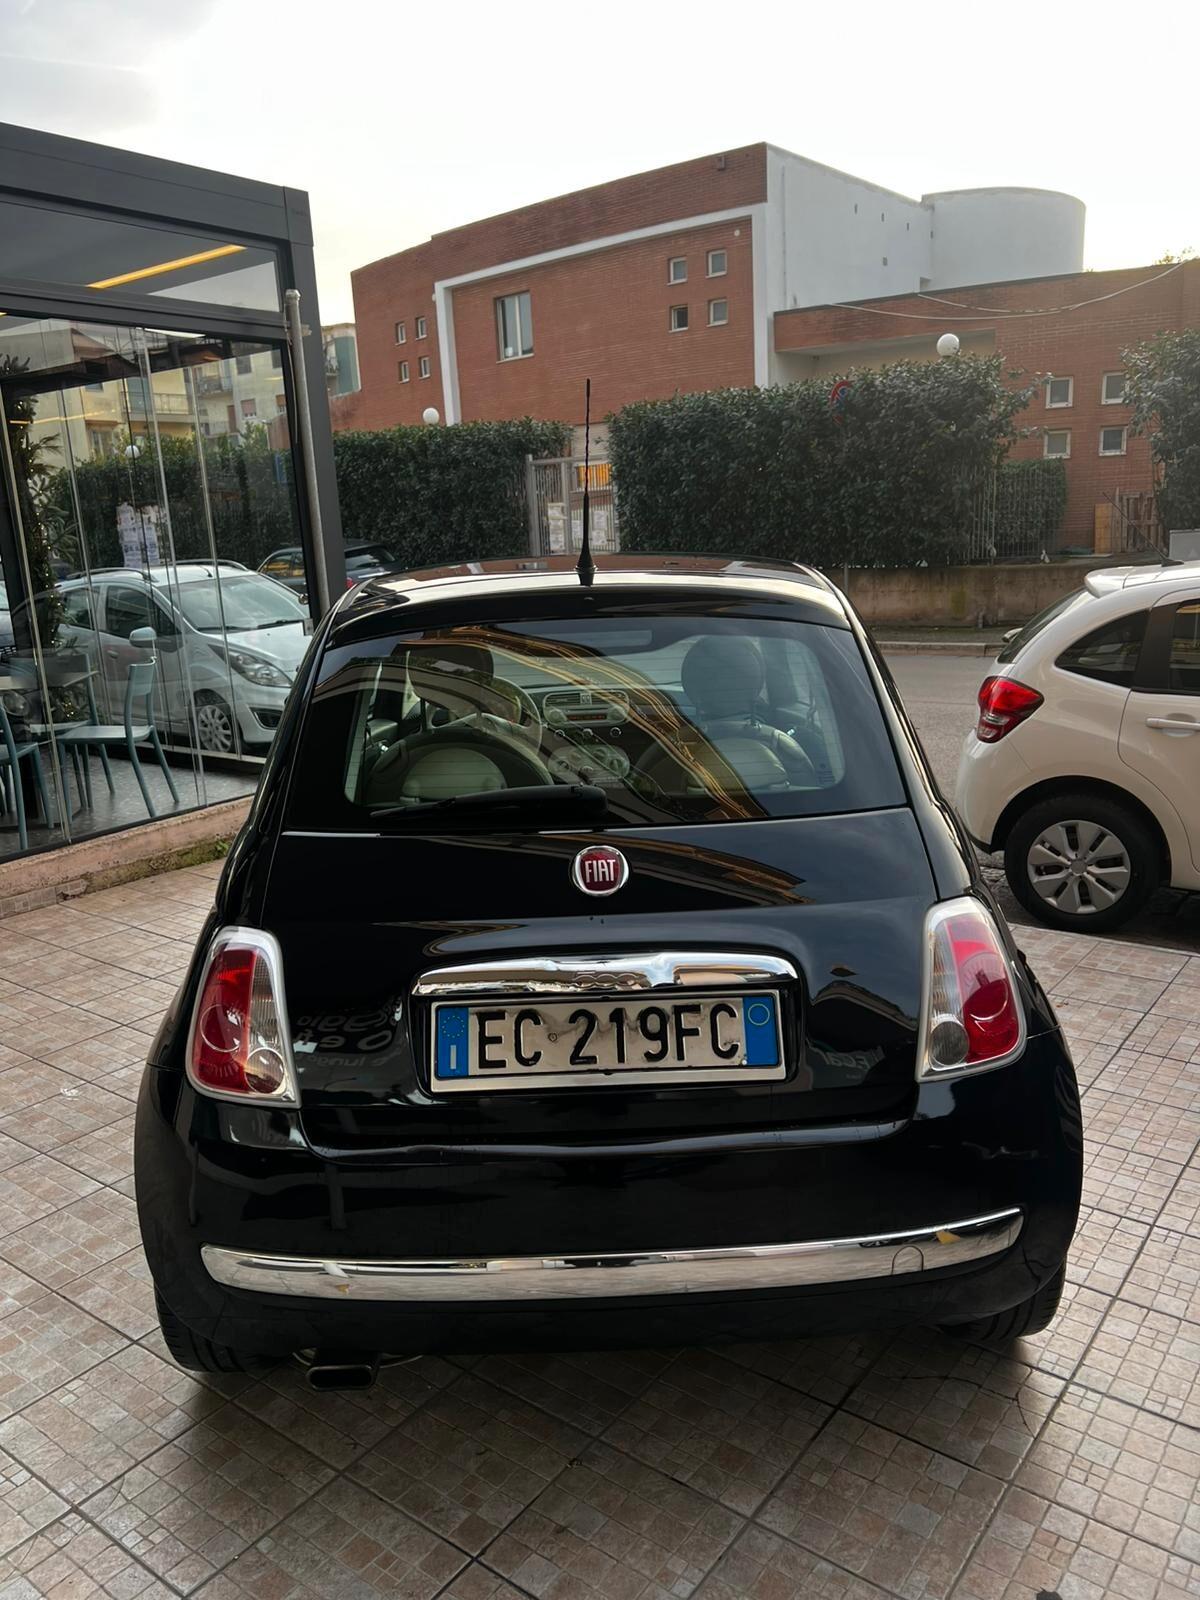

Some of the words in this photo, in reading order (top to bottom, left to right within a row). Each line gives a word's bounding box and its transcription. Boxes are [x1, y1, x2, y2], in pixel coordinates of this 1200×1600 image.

[584, 859, 616, 883] FIAT
[476, 1008, 542, 1069] EC
[568, 1003, 740, 1065] 219FC
[450, 1045, 457, 1070] I
